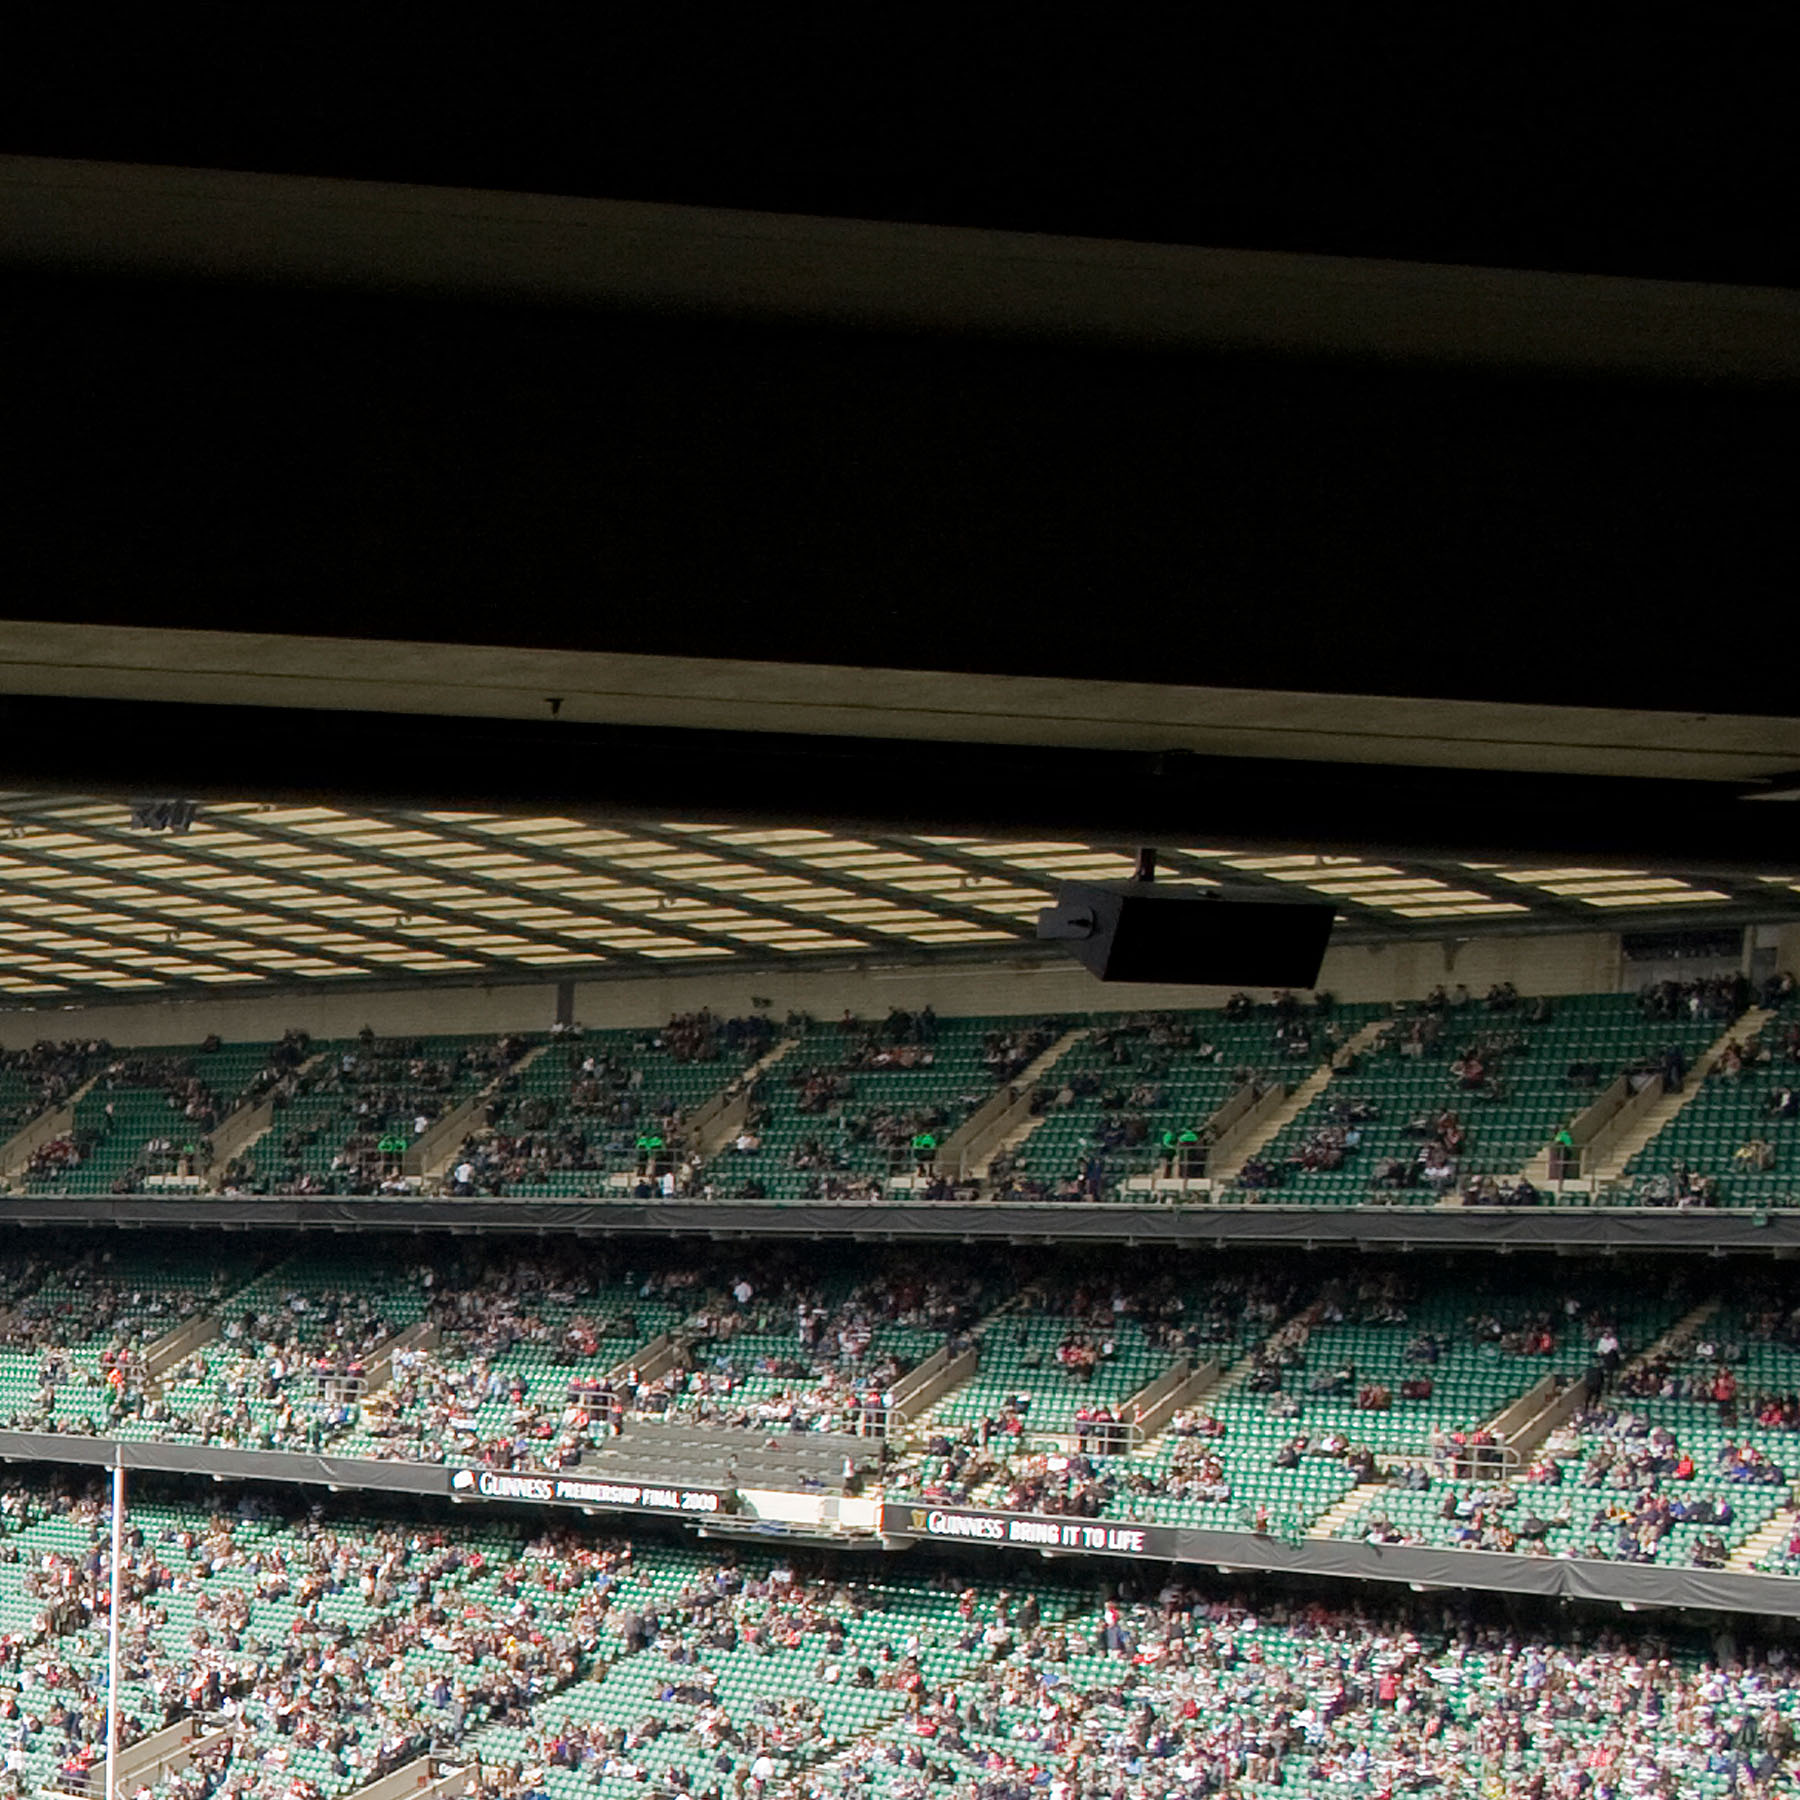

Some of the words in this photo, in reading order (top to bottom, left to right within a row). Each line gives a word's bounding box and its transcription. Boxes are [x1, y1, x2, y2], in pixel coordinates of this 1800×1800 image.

[479, 1472, 553, 1500] GUINNESS
[556, 1481, 641, 1504] PREMIERSHIP
[642, 1489, 681, 1509] FINAL
[927, 1511, 1005, 1539] GUINNESS
[1009, 1520, 1060, 1544] BRING
[1062, 1526, 1082, 1546] IT
[1083, 1527, 1106, 1548] TO
[1107, 1529, 1147, 1552] LIFE
